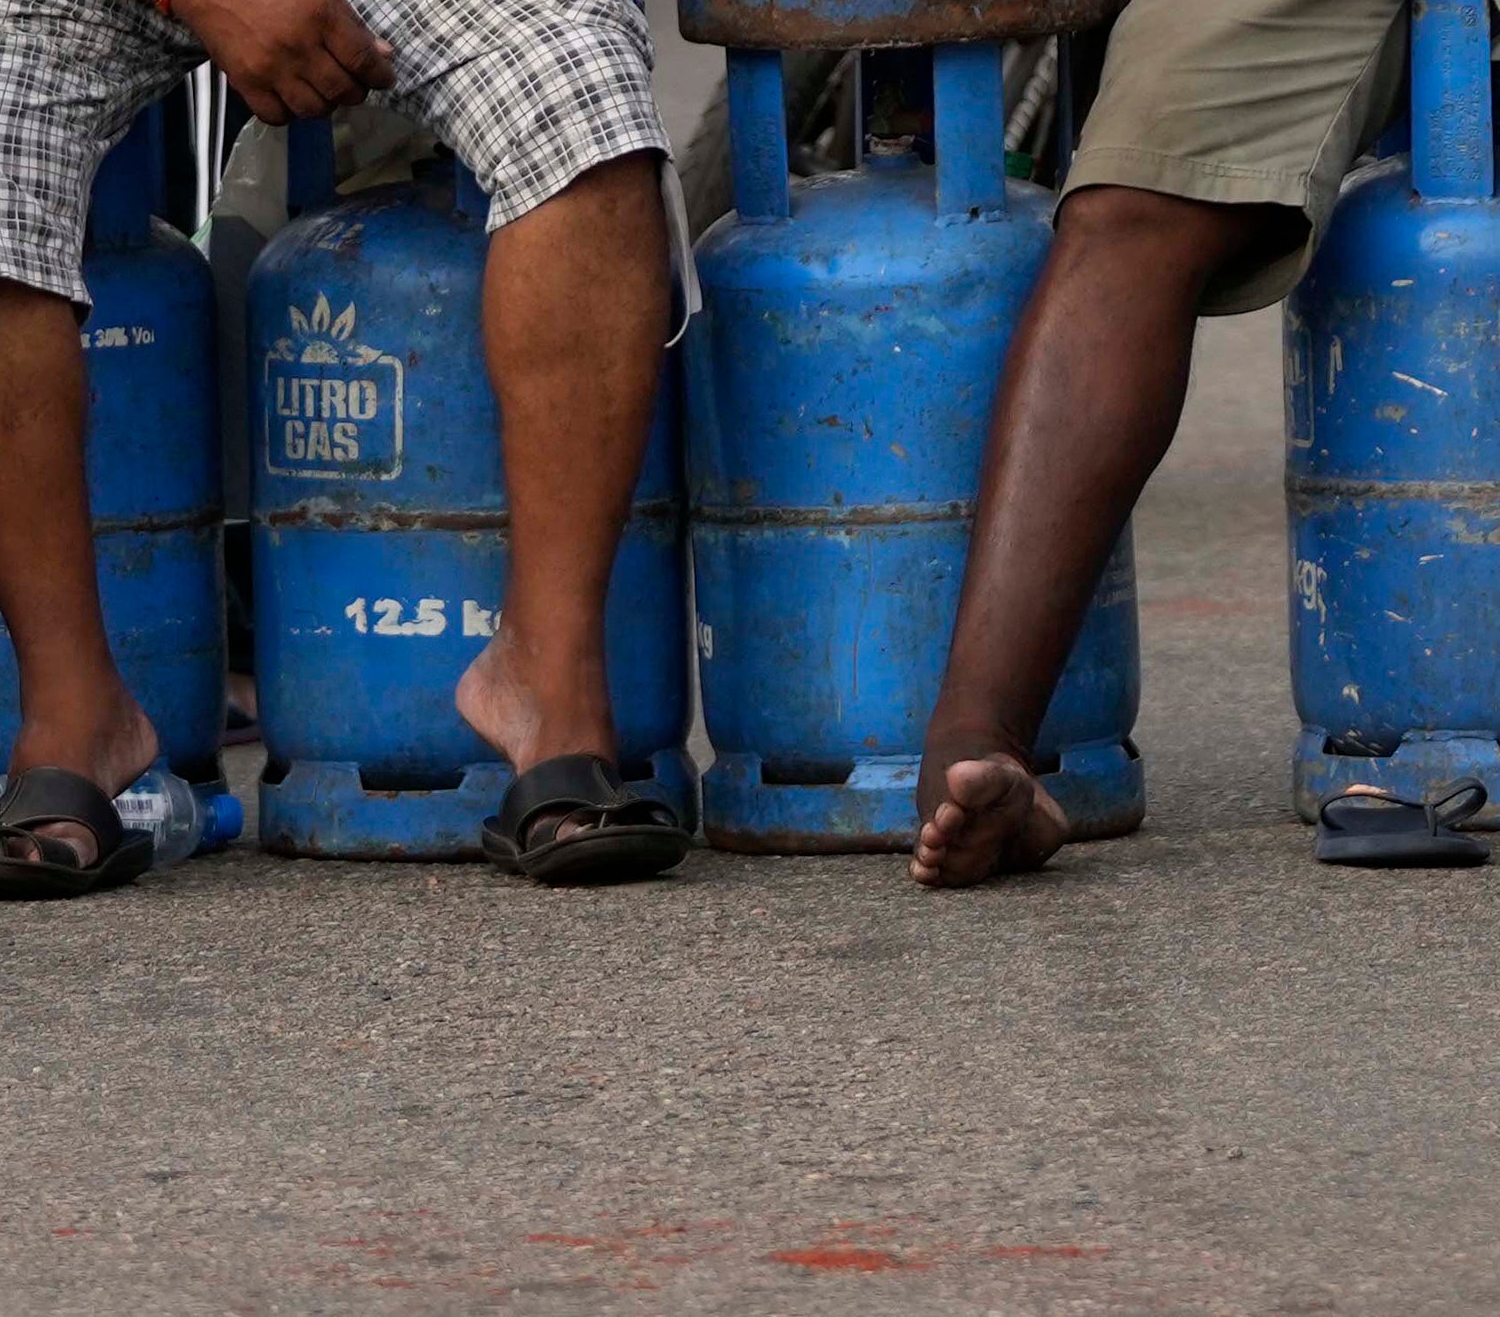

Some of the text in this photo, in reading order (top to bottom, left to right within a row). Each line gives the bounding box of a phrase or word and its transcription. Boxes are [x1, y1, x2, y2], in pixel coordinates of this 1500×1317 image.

[275, 376, 378, 421] LITRO
[284, 420, 360, 462] GAS
[462, 598, 502, 637] k
